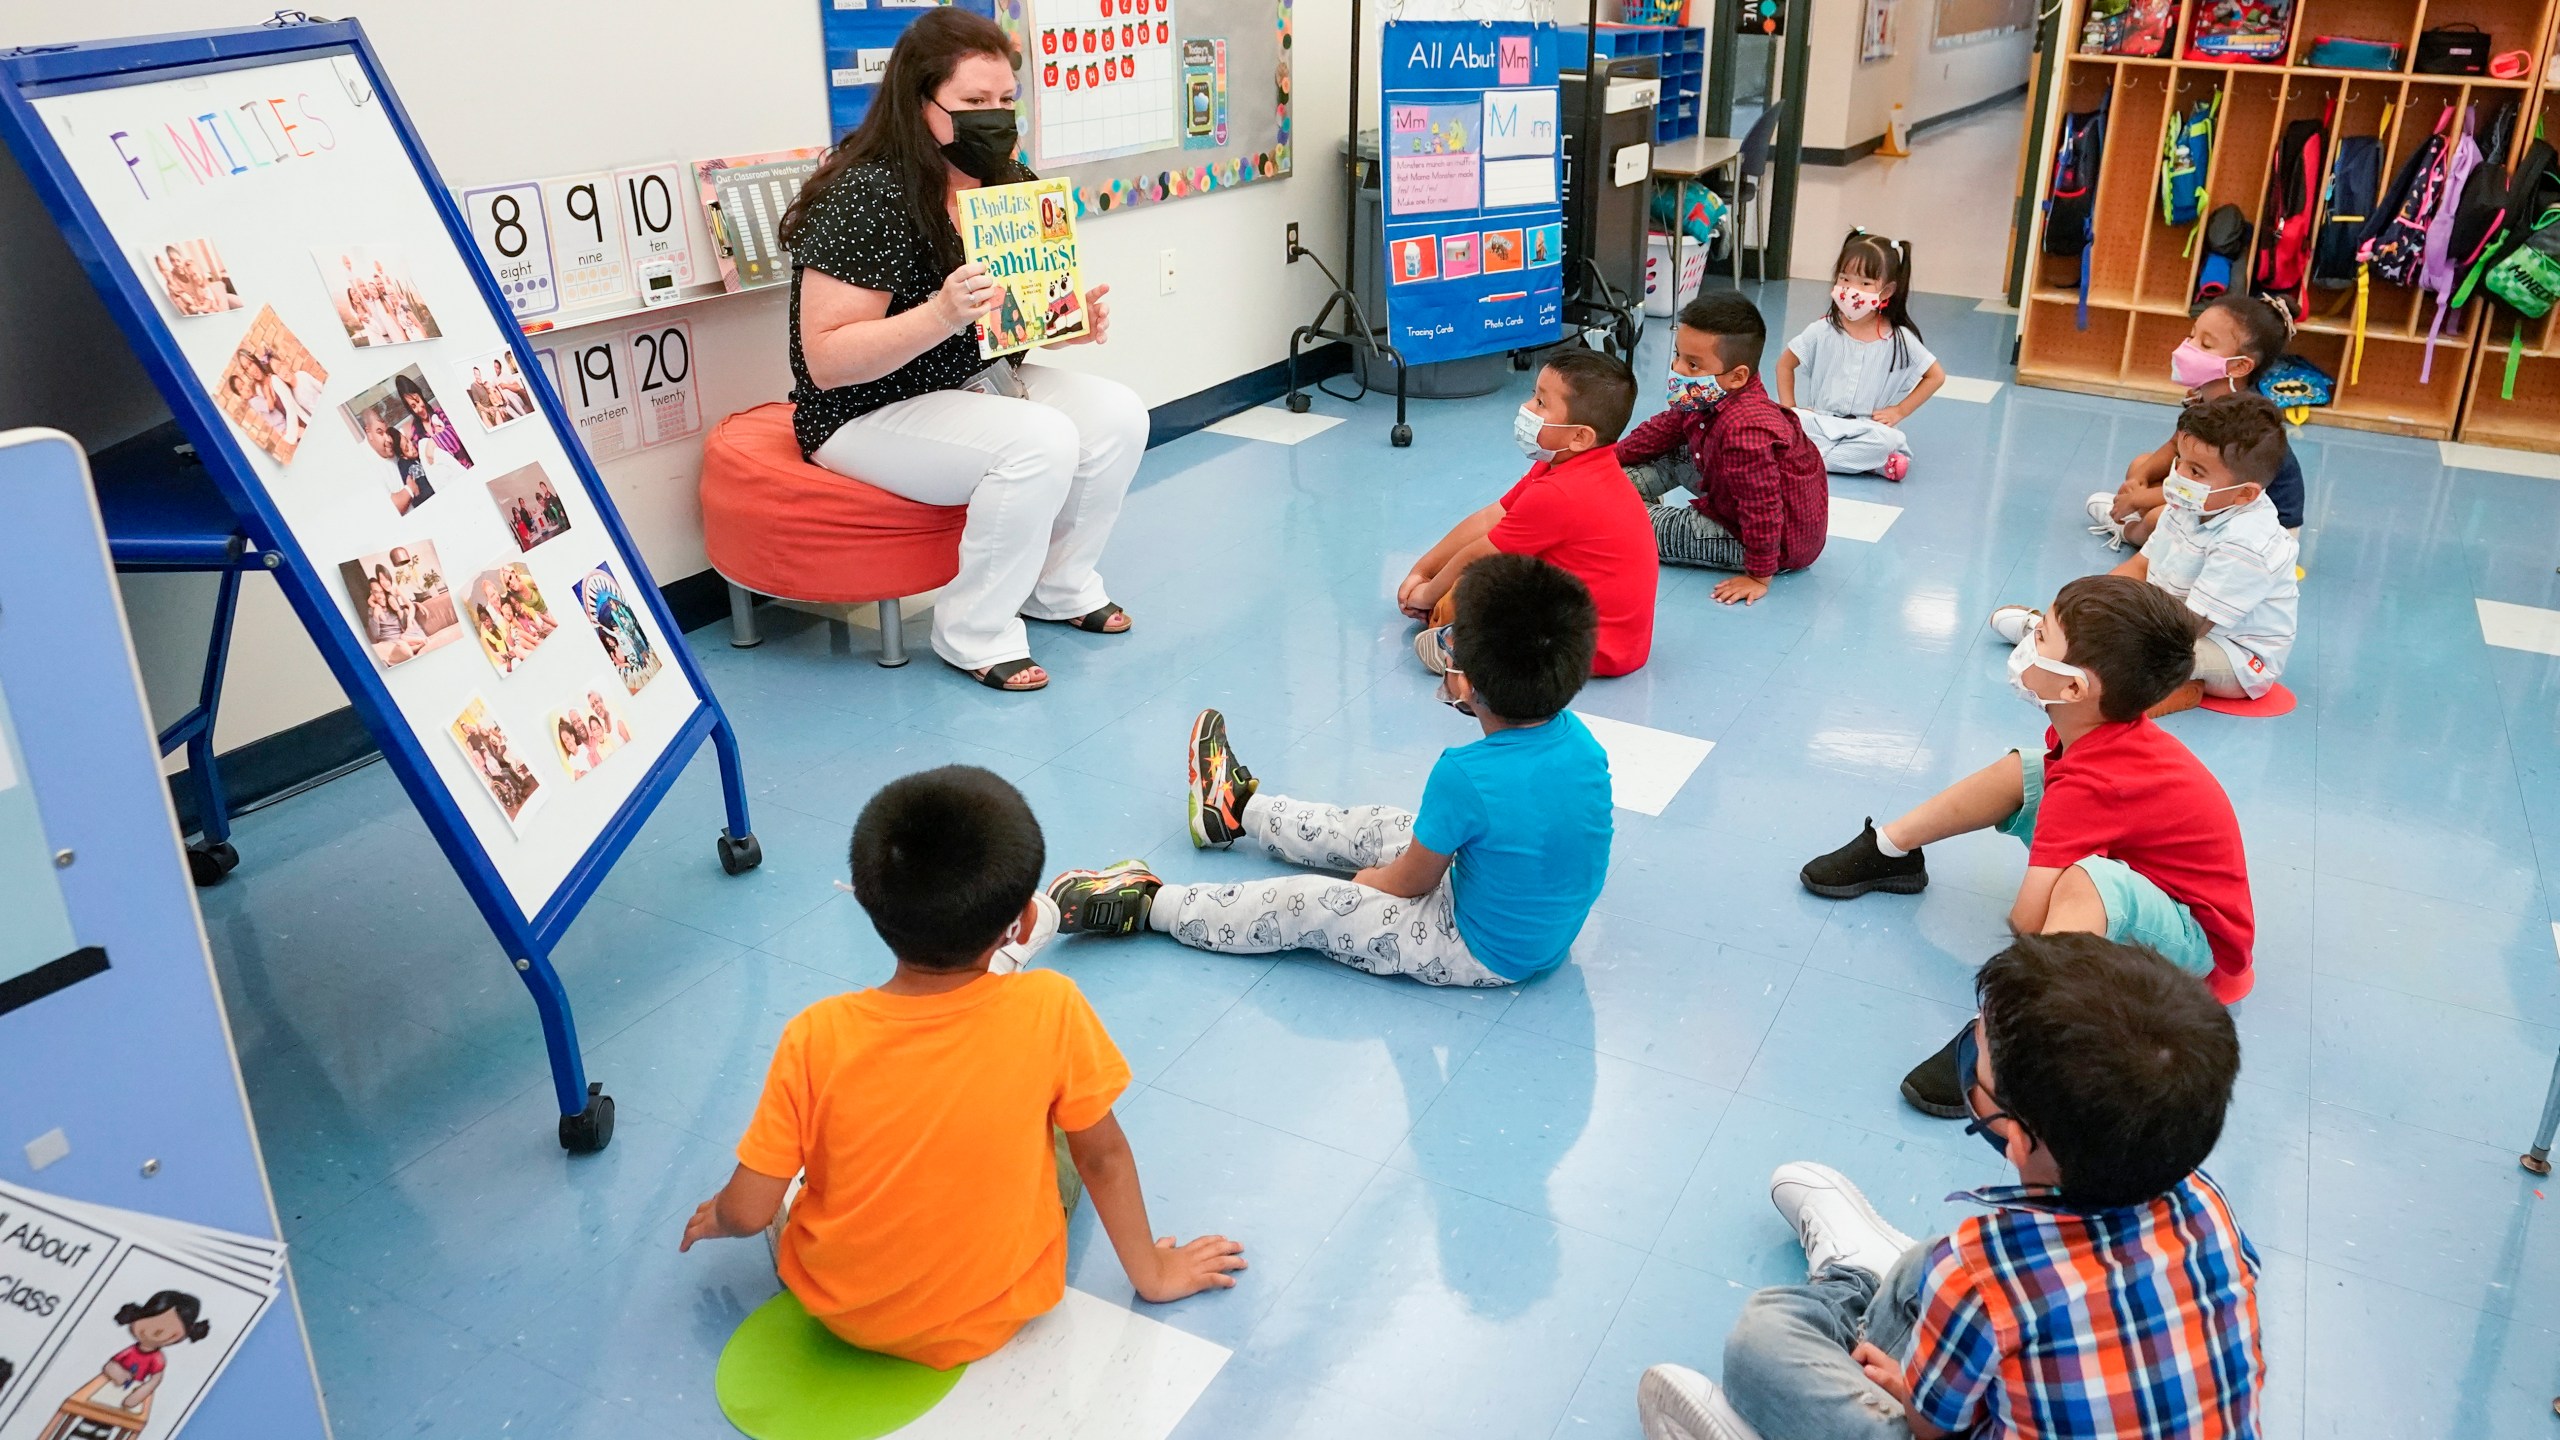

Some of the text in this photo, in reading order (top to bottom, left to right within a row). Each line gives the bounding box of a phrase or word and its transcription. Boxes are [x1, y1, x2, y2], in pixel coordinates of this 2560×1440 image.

[1046, 38, 1053, 50] 5
[1066, 36, 1074, 48] 6
[1087, 37, 1093, 48] 7
[1105, 35, 1111, 47] 8
[1125, 33, 1131, 43] 9
[1139, 29, 1148, 40] 10
[864, 57, 888, 73] Lun
[1408, 42, 1442, 68] All
[1501, 45, 1529, 68] Mm
[1535, 46, 1538, 67] !
[1047, 62, 1131, 86] 12 13 14 15 16
[1396, 110, 1425, 129] Mm
[1490, 103, 1551, 138] M m
[109, 92, 336, 201] FAMILIES
[716, 175, 731, 184] Our
[733, 170, 771, 182] Classroom
[771, 165, 801, 177] Weather
[1396, 161, 1425, 170] Monsters
[1431, 170, 1456, 180] Monster
[566, 183, 603, 243] 9
[629, 174, 672, 236] 10
[491, 194, 528, 258] 8
[648, 240, 669, 252] ten
[578, 252, 603, 266] nine
[500, 261, 533, 282] eight
[1539, 304, 1557, 314] Letter
[1406, 323, 1455, 340] Tracing Cards
[1484, 315, 1524, 329] Photo Cards
[1539, 316, 1556, 326] Cards
[634, 327, 689, 392] 20
[574, 343, 619, 408] 19
[651, 388, 687, 407] twenty
[580, 406, 629, 428] nineteen
[2, 1222, 92, 1269] About
